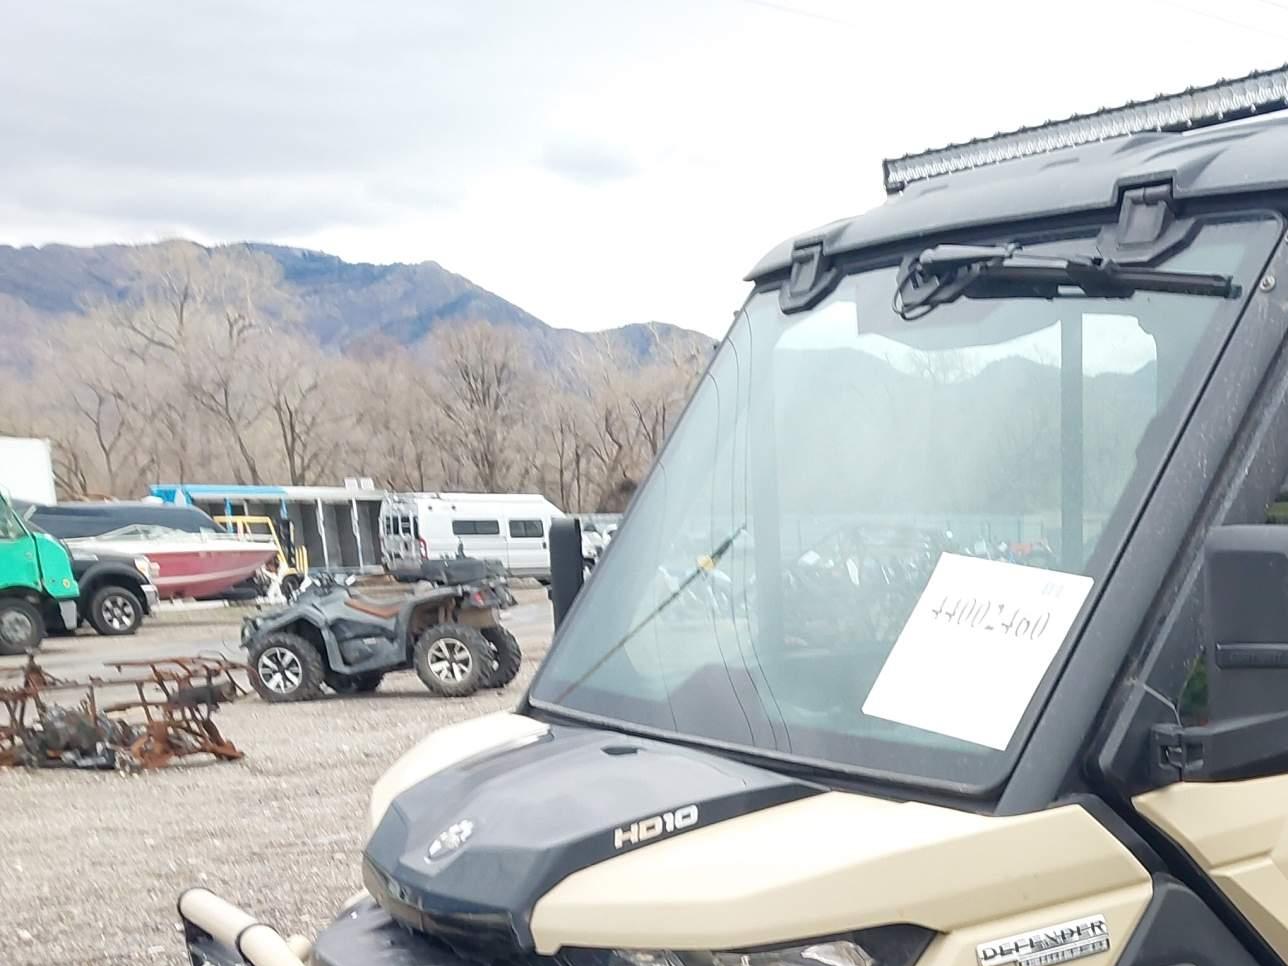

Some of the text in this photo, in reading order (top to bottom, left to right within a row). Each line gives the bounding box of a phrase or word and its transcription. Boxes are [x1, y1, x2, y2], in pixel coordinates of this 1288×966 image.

[931, 596, 1051, 641] 44002460
[614, 804, 699, 850] HD10
[982, 919, 1105, 961] DEFENDER
